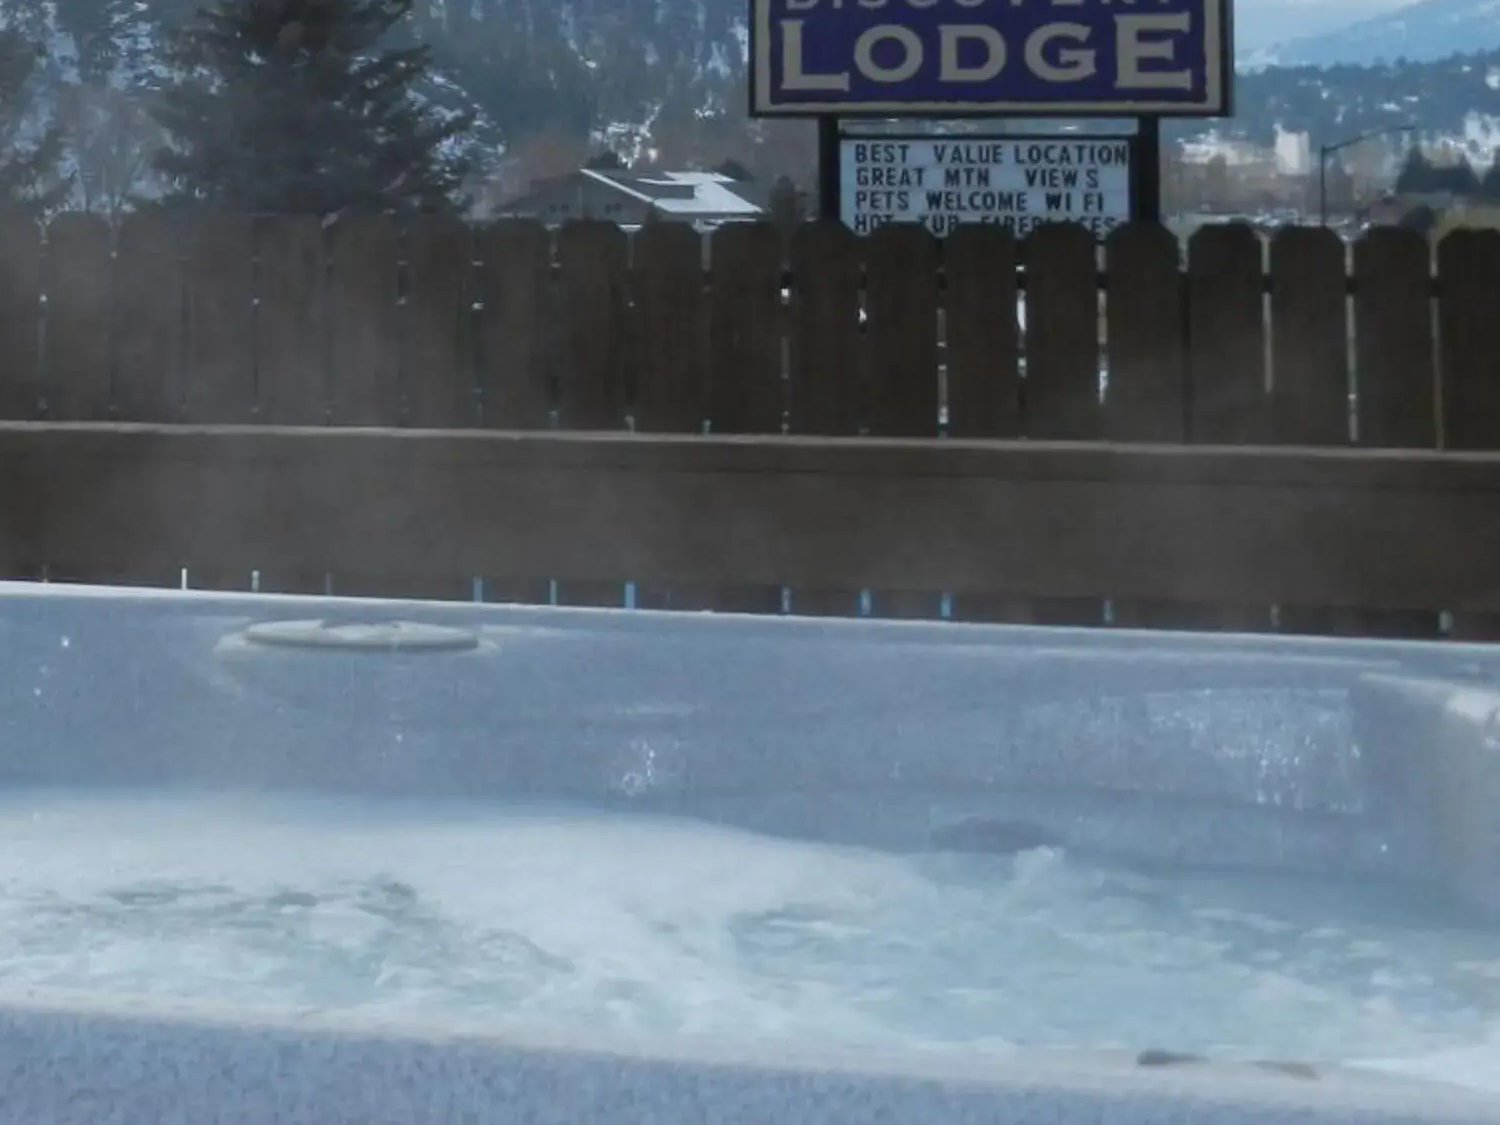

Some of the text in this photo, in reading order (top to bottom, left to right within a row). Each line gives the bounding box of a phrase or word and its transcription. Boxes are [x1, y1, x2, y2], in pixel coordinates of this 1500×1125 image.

[780, 12, 1192, 92] LODGE
[854, 143, 1128, 165] BEST VALUE LOCATION
[855, 167, 1100, 188] GREAT MTN VIEWS
[854, 190, 909, 211] PETS
[925, 190, 1028, 212] WELCOME
